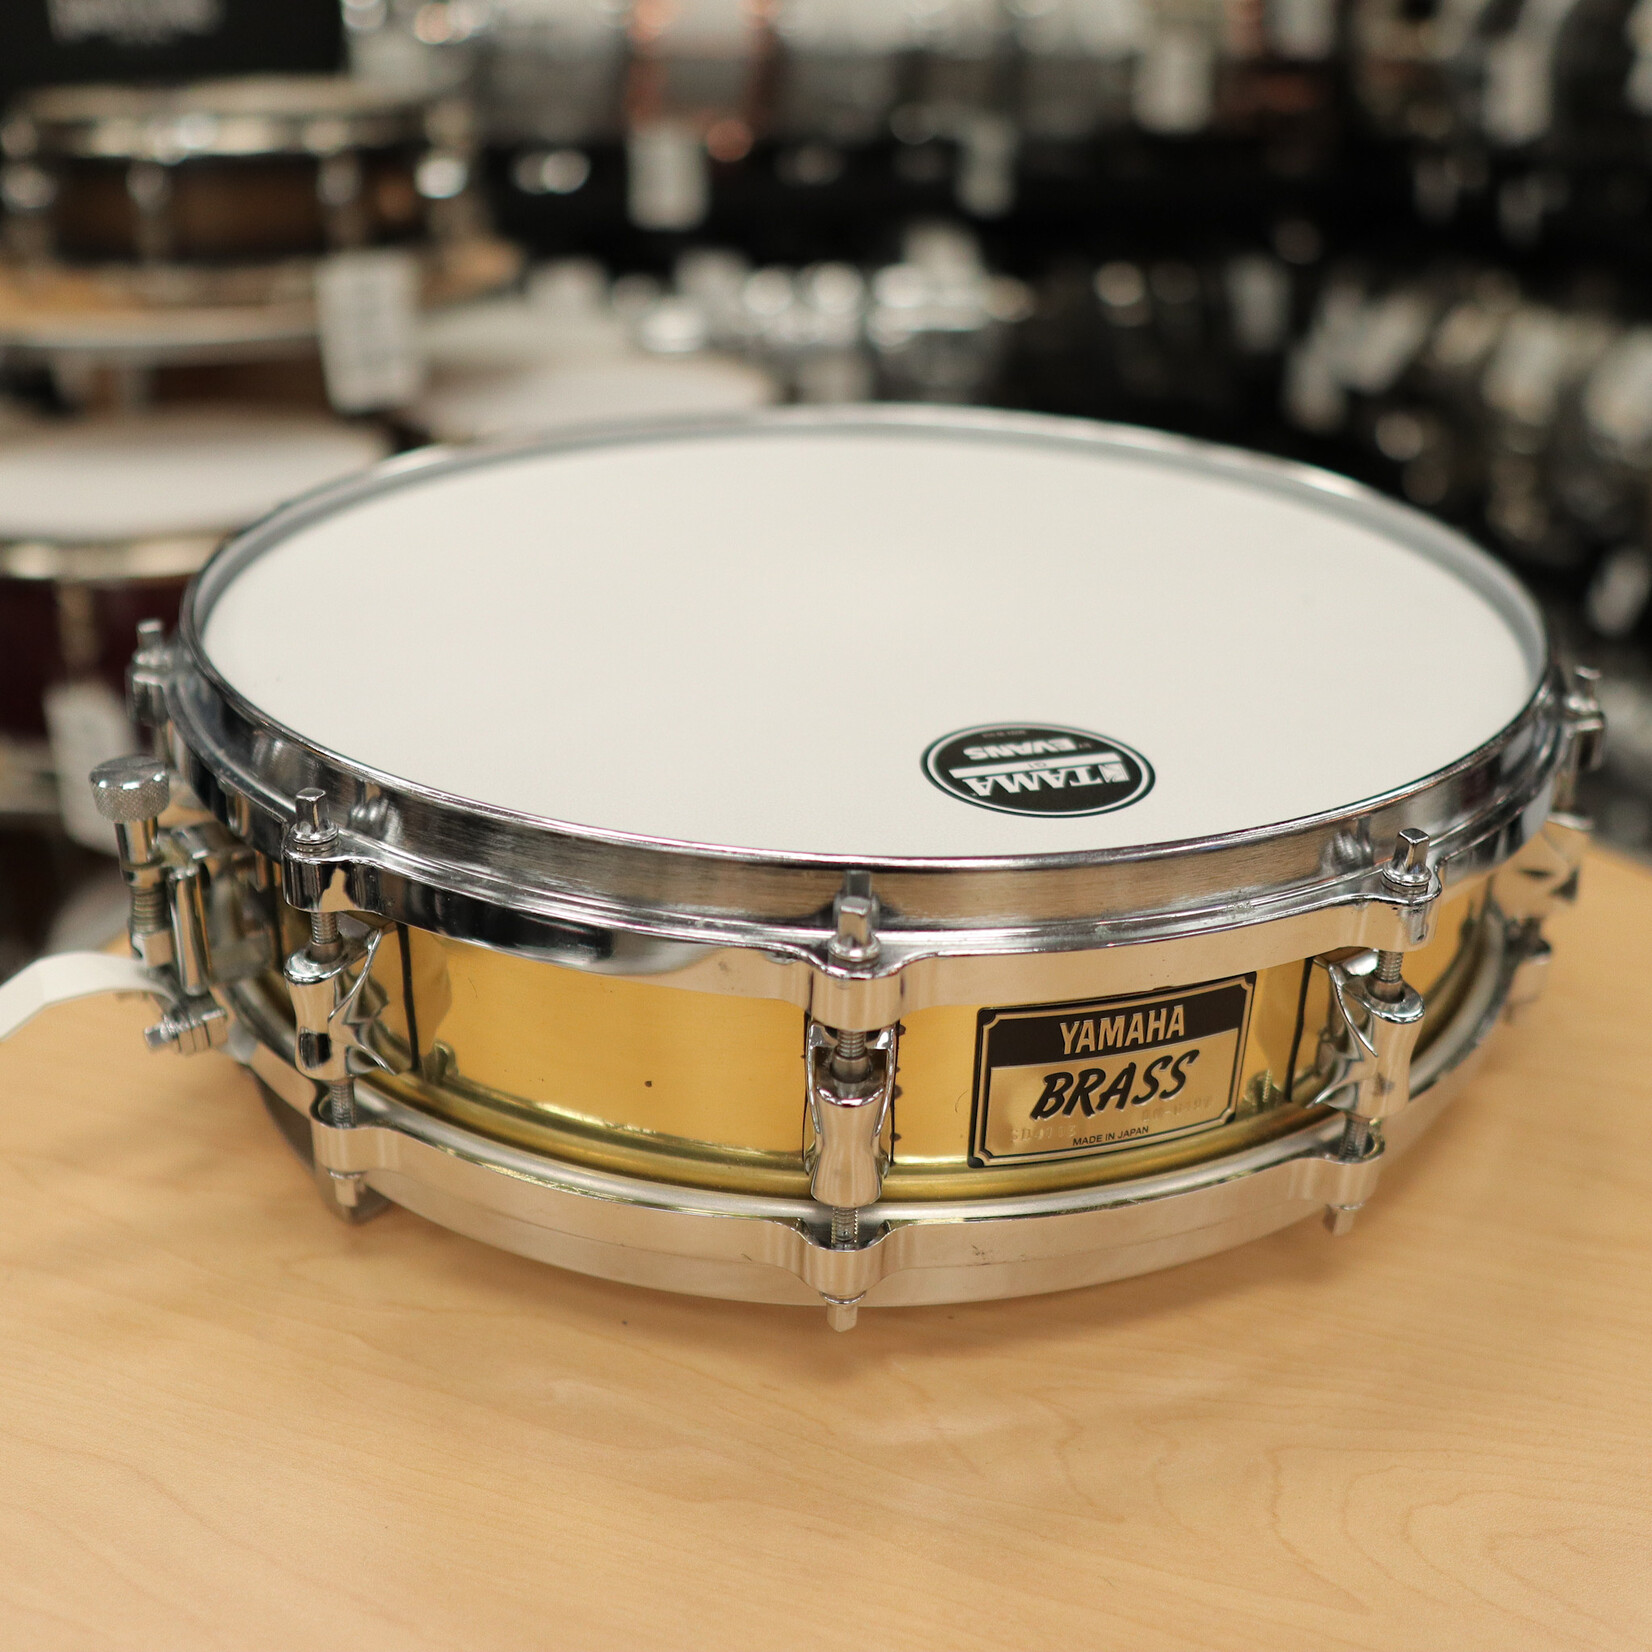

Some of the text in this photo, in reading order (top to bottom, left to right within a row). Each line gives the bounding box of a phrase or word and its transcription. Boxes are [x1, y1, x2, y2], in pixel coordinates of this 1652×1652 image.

[963, 737, 1075, 761] EVANS
[962, 765, 1100, 797] TAMA
[1060, 1004, 1185, 1055] YAMAHA
[1030, 1049, 1200, 1121] BRASS
[1072, 1125, 1150, 1146] MADE IN JAPAN
